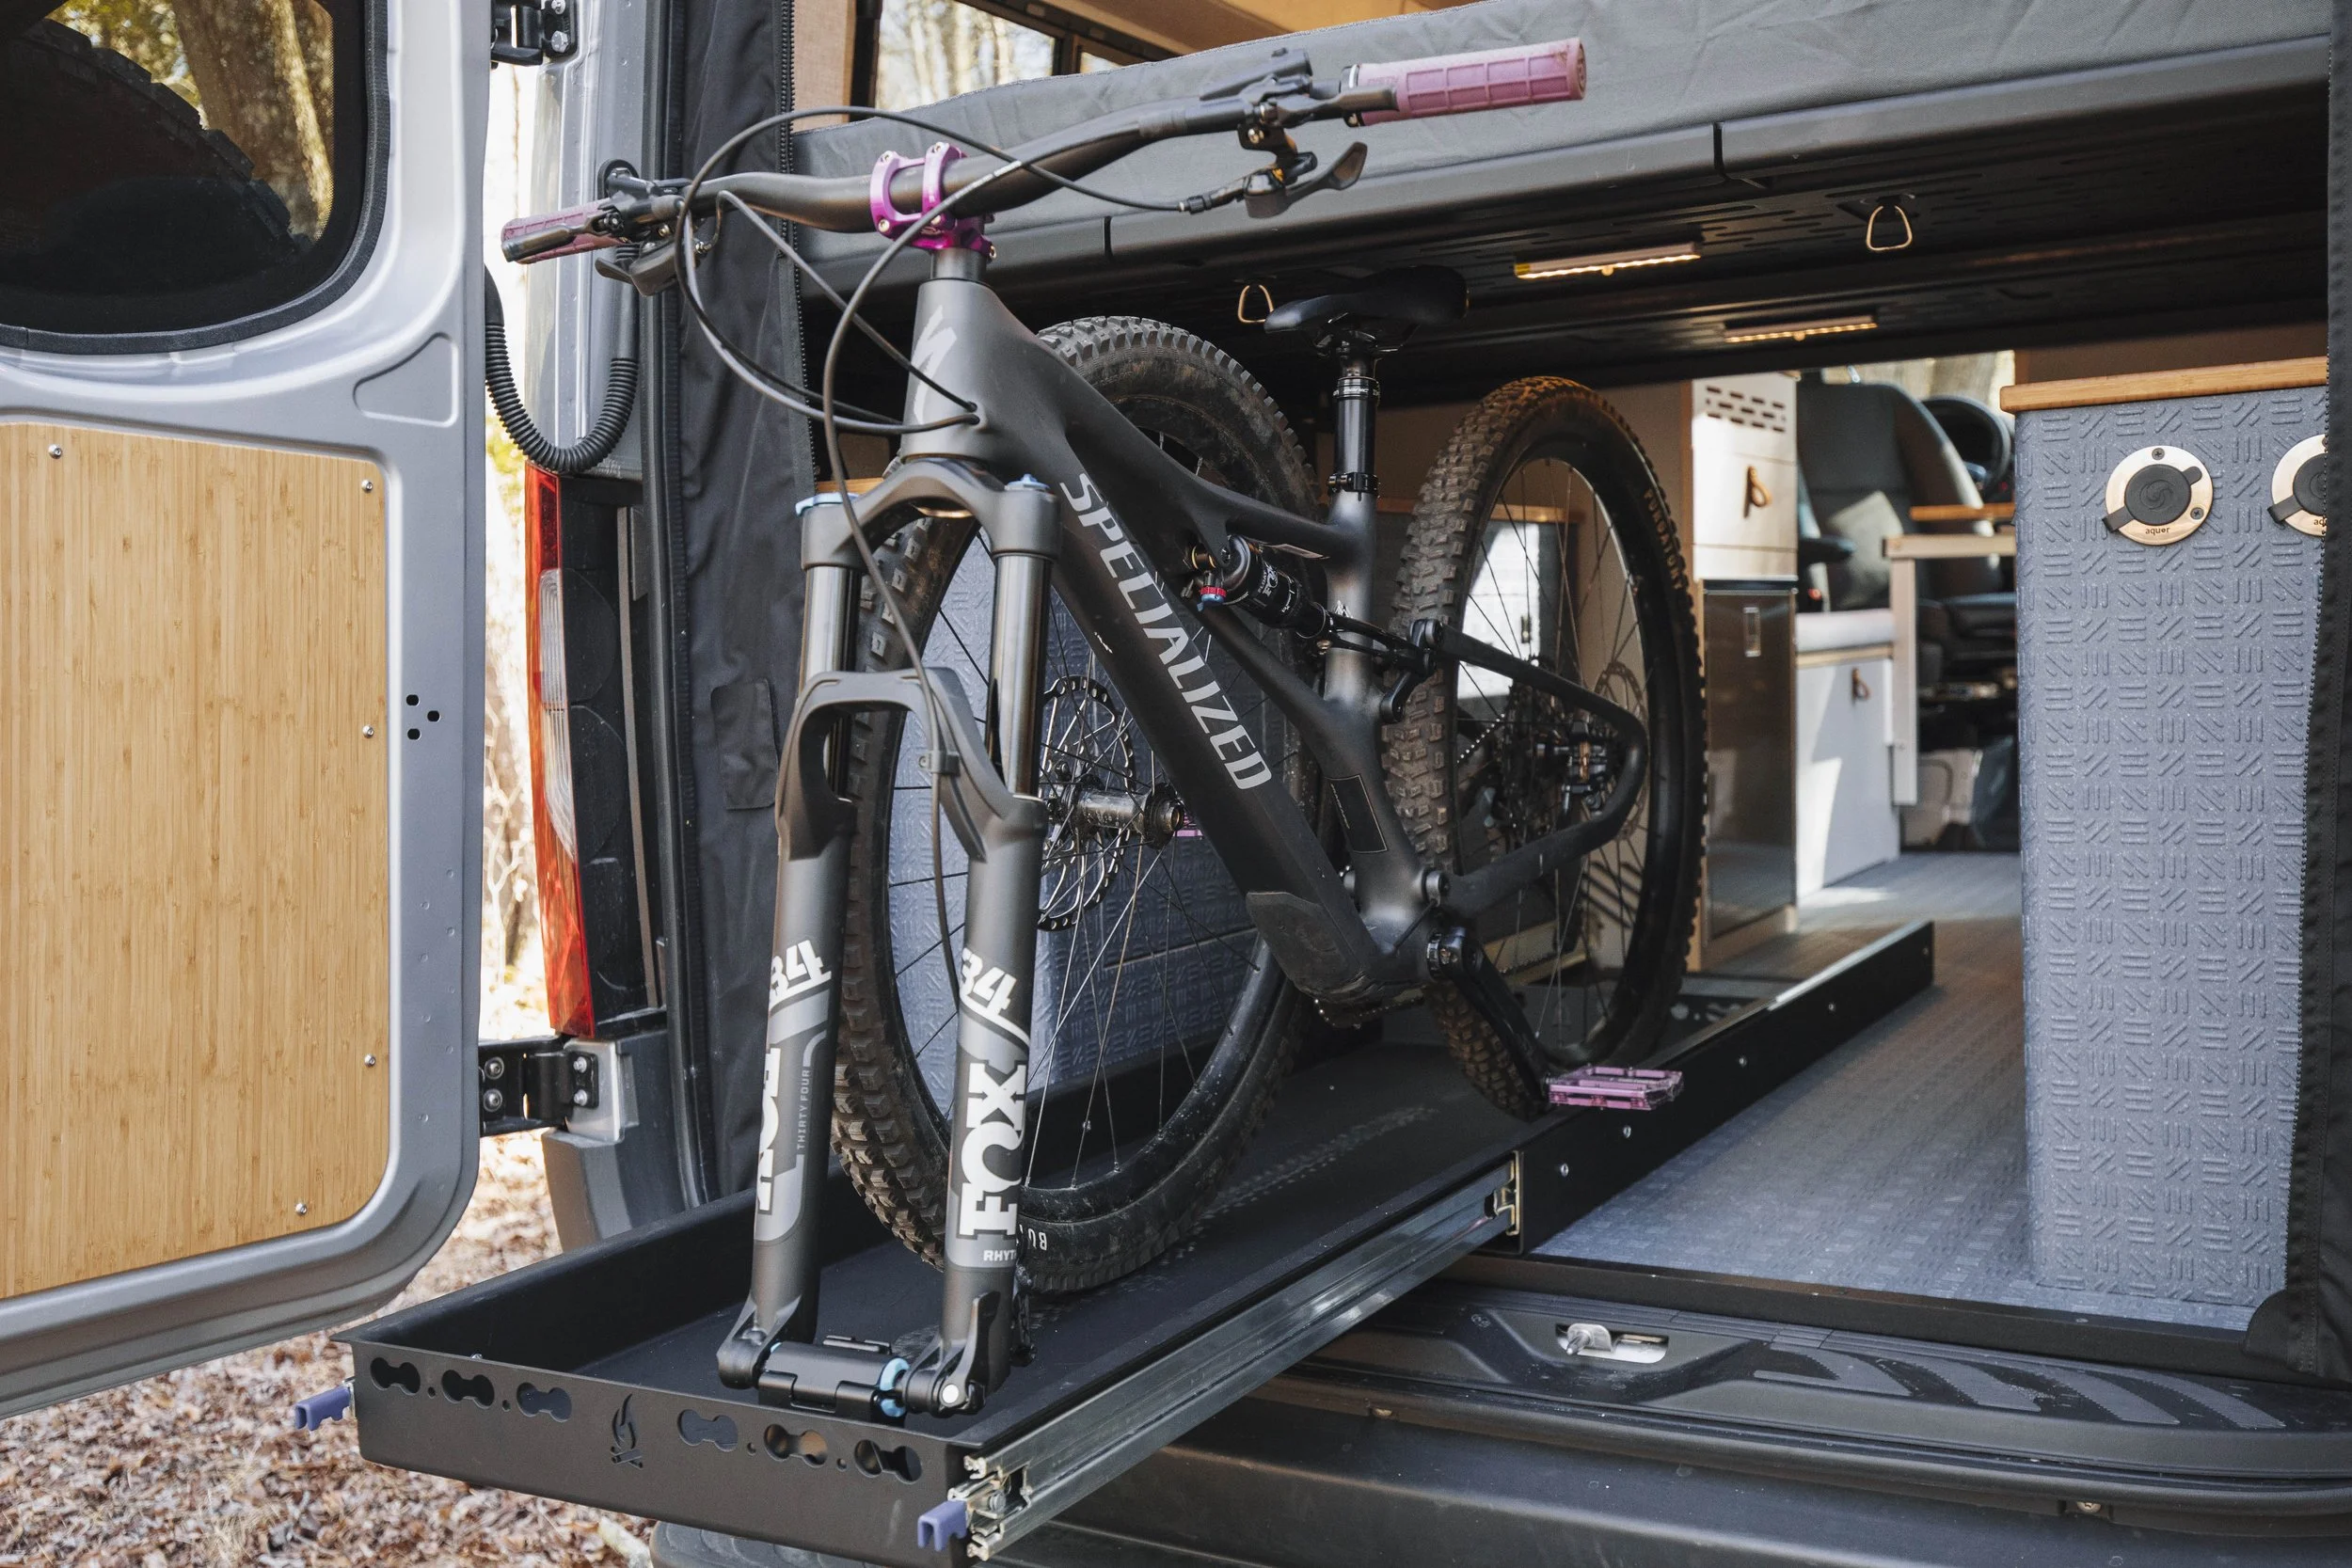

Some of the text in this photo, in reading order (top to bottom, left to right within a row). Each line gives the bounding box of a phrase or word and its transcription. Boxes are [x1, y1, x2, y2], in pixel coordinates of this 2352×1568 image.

[1060, 473, 1272, 790] SPECIALIZED
[960, 947, 1017, 1017] 34
[797, 1069, 810, 1149] THIRTY FOUR
[960, 1062, 1027, 1236] FOX
[983, 1249, 1017, 1261] RHYT
